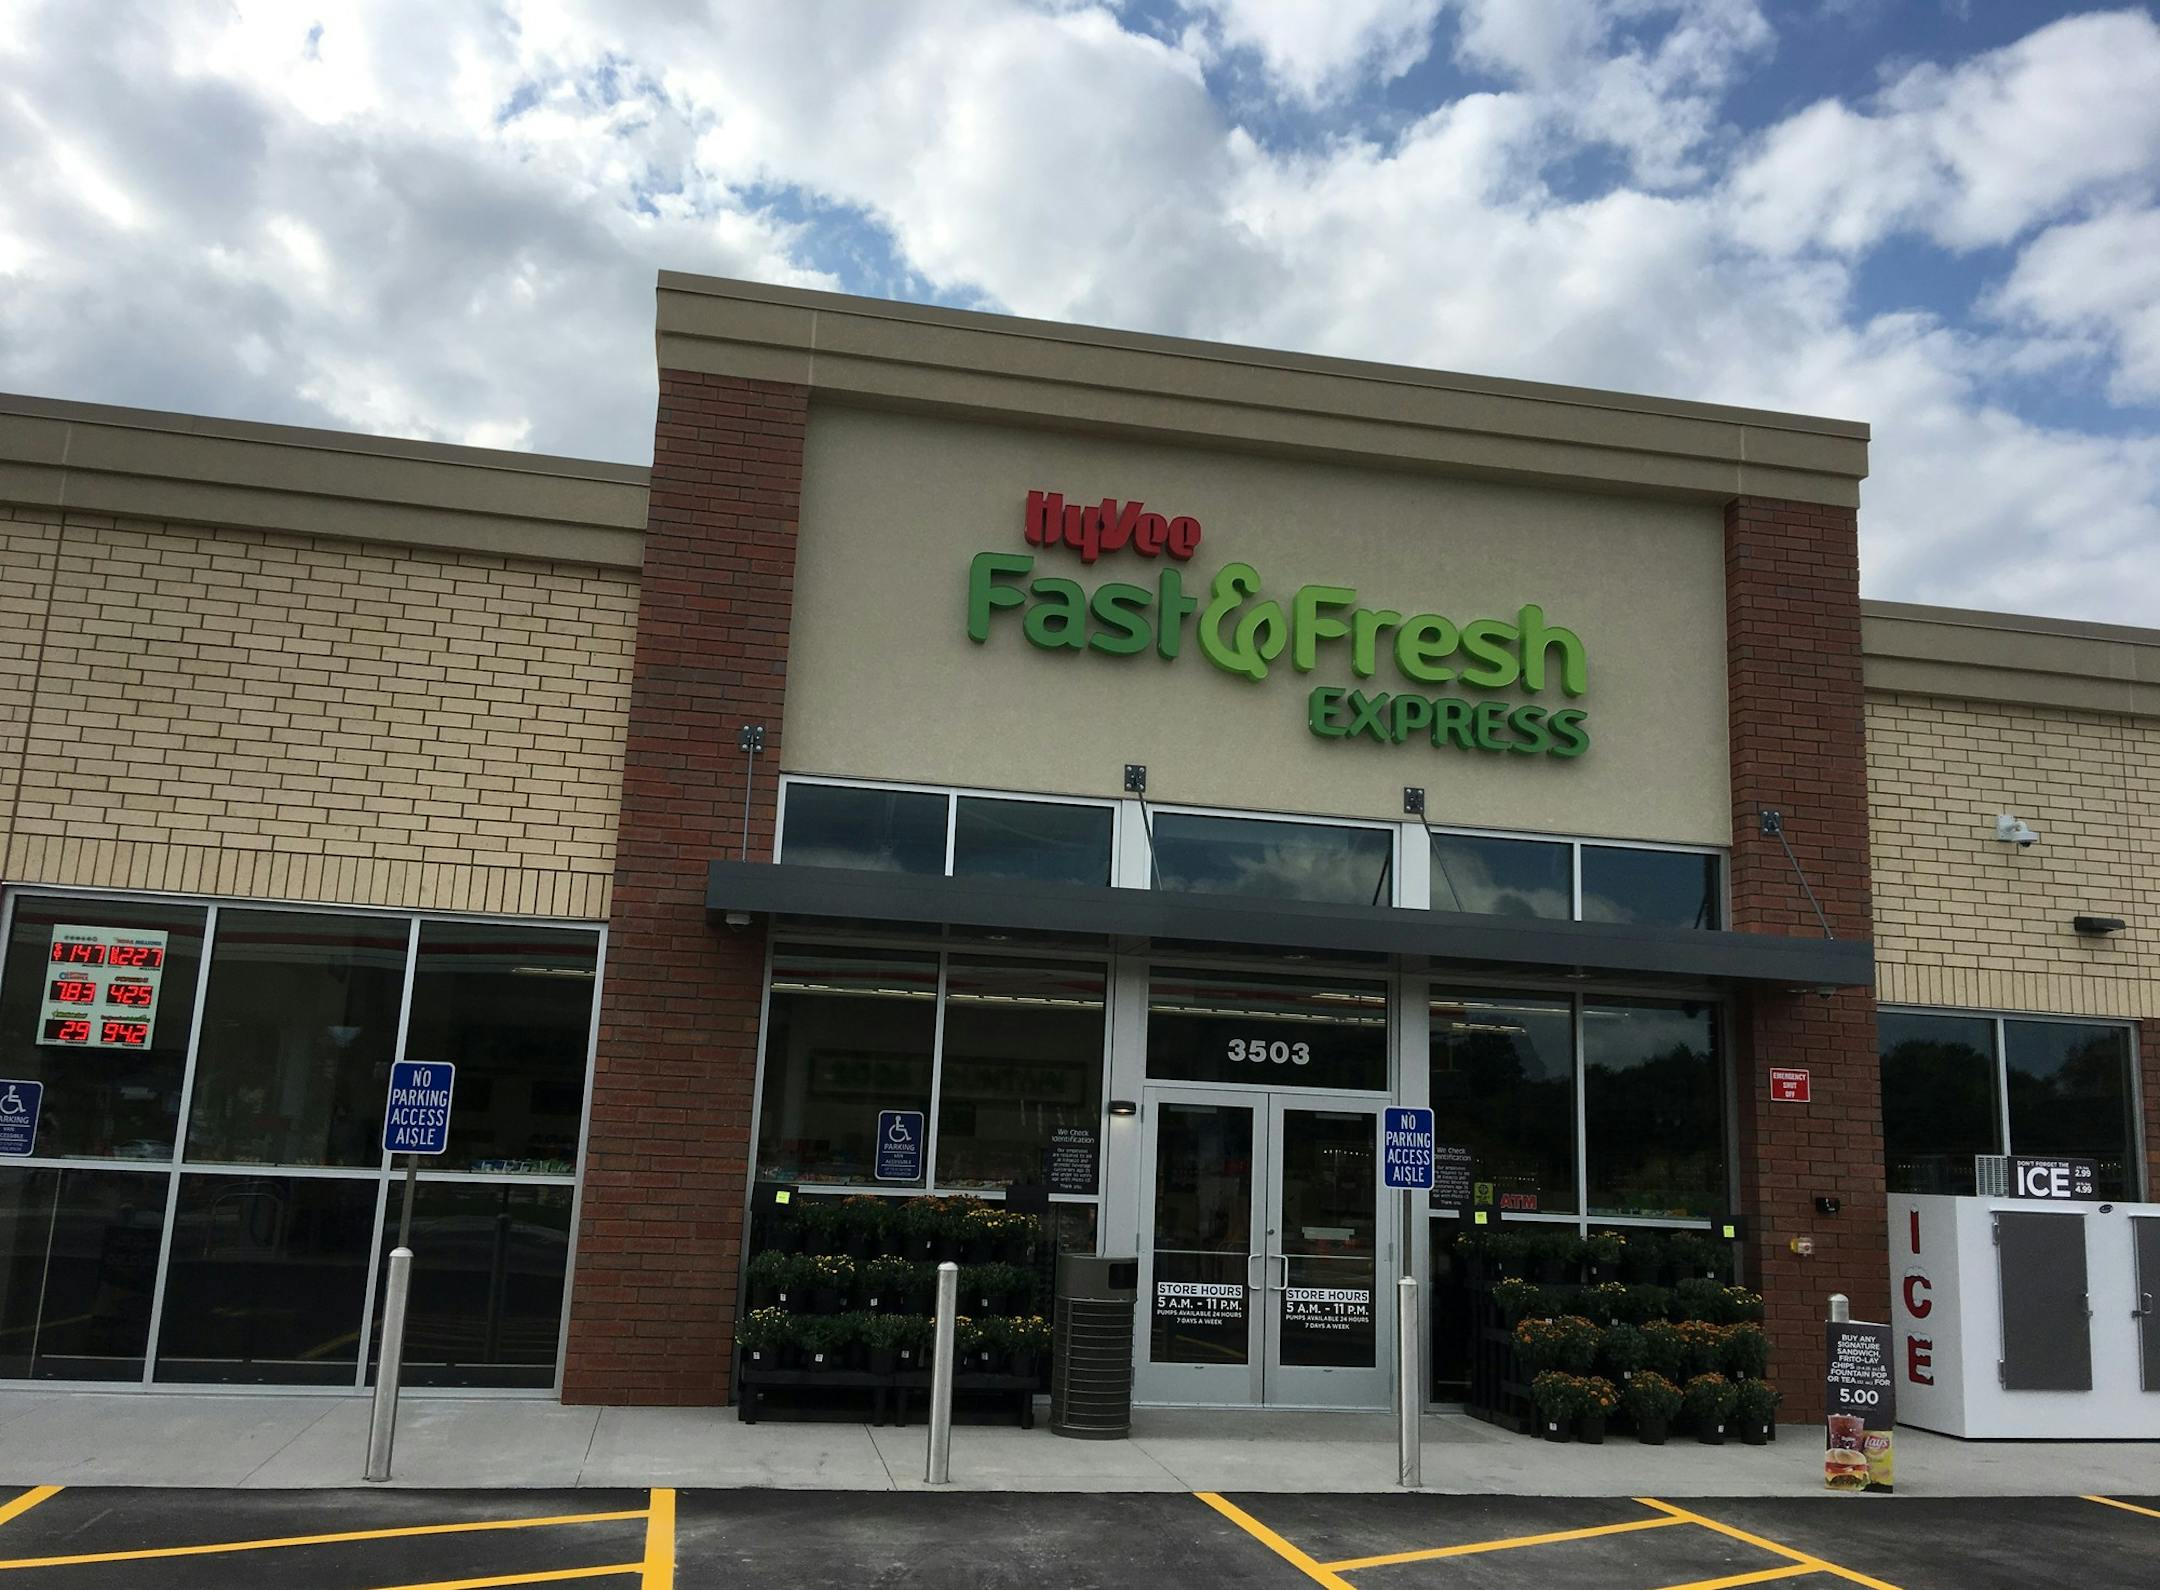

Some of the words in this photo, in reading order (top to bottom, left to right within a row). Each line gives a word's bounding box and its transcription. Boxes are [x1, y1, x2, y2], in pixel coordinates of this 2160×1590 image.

[967, 551, 1197, 660] Fast
[1292, 584, 1589, 697] Fresh
[1308, 685, 1591, 758] EXPRESS
[59, 1021, 91, 1039] 29
[1228, 1038, 1310, 1065] 3503
[412, 1070, 432, 1087] NO
[391, 1089, 448, 1107] PARKING
[390, 1108, 445, 1126] ACCESS
[1401, 1114, 1416, 1130] NO
[395, 1127, 436, 1145] AISLE
[1386, 1131, 1431, 1148] PARKING
[884, 1143, 915, 1151] PARKING
[1387, 1148, 1430, 1165] ACCESS
[1393, 1165, 1425, 1183] AISLE
[2074, 1169, 2091, 1177] 2.99
[2017, 1166, 2071, 1197] ICE
[2075, 1185, 2093, 1194] 4.99
[1500, 1193, 1537, 1210] ATM
[1159, 1284, 1198, 1294] STORE
[1201, 1285, 1242, 1296] HOURS
[1287, 1290, 1325, 1300] STORE
[1328, 1291, 1368, 1301] HOURS
[1157, 1296, 1166, 1307] 5
[1168, 1298, 1193, 1308] A.M.
[1206, 1297, 1217, 1309] 11
[1220, 1299, 1242, 1310] P.M.
[1286, 1302, 1294, 1313] 5
[1297, 1303, 1321, 1313] A.M.
[1333, 1303, 1345, 1314] 11
[1347, 1305, 1369, 1315] P.M.
[1837, 1341, 1880, 1350] SIGNATURE
[1860, 1335, 1876, 1343] ANY
[1837, 1348, 1881, 1358] SANDWICH,
[1839, 1355, 1879, 1364] FRITO-LAY
[1830, 1368, 1870, 1377] FOUNTAIN
[1832, 1362, 1855, 1370] CHIPS
[1841, 1376, 1857, 1384] TEA
[1840, 1388, 1879, 1405] 5.00
